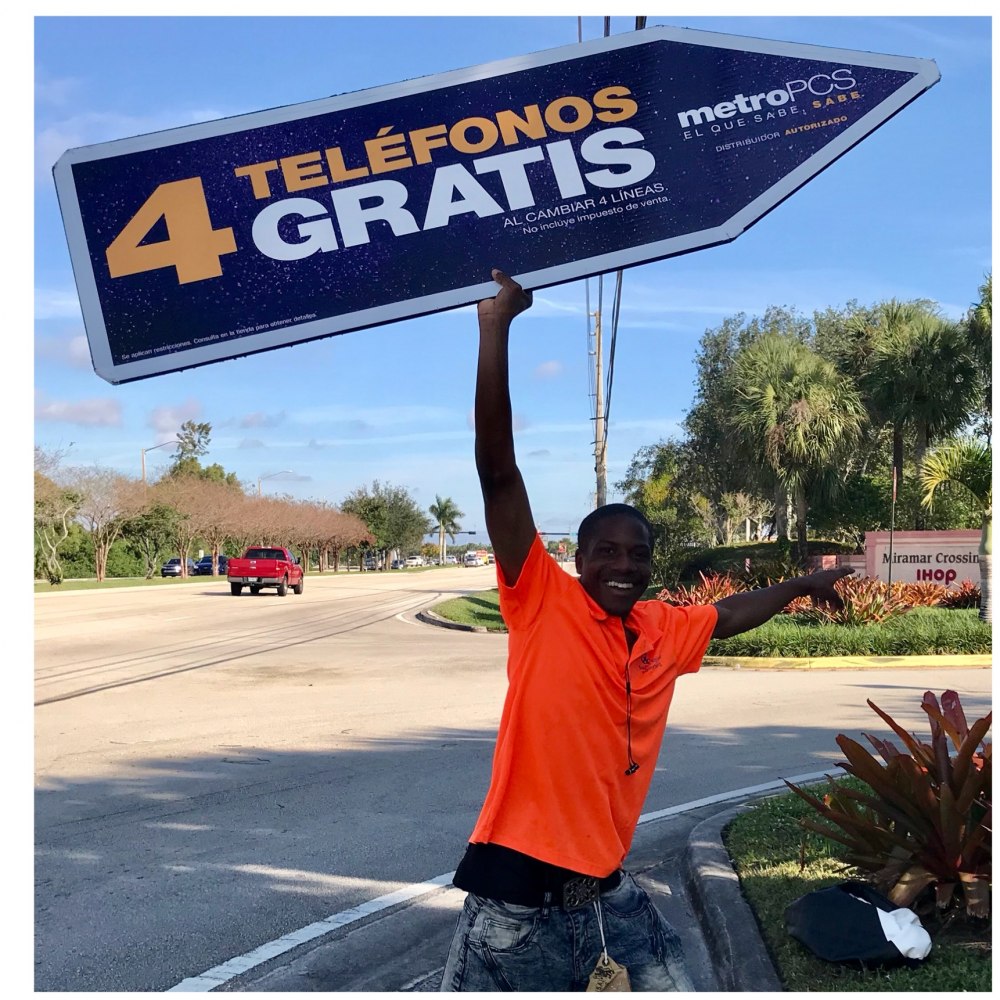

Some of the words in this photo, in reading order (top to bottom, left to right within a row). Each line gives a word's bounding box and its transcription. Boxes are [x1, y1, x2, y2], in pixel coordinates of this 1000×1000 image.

[677, 68, 857, 128] metroPCS
[683, 128, 704, 140] EL
[711, 118, 746, 133] QUE
[812, 91, 865, 109] SABE.
[715, 131, 781, 152] DISTRIBUIDOR
[784, 115, 848, 136] AUTORIZADO
[105, 176, 238, 285] 4
[234, 85, 638, 199] TELÉFONOS
[251, 126, 656, 261] GRATIS
[503, 217, 523, 229] AL
[525, 199, 596, 223] CAMBIAR
[598, 195, 608, 206] 4
[611, 182, 669, 203] LÍNEAS.
[522, 226, 538, 235] No
[540, 217, 575, 232] incluye
[577, 206, 624, 223] impuesto
[626, 201, 638, 210] de
[640, 196, 671, 208] venta.
[131, 348, 153, 359] aplican
[193, 333, 220, 344] Consulta
[236, 325, 255, 334] tienda
[255, 323, 270, 332] para
[270, 319, 293, 328] obtener
[882, 553, 932, 564] Miramar
[936, 552, 980, 564] Crossin
[916, 569, 957, 585] IHOP
